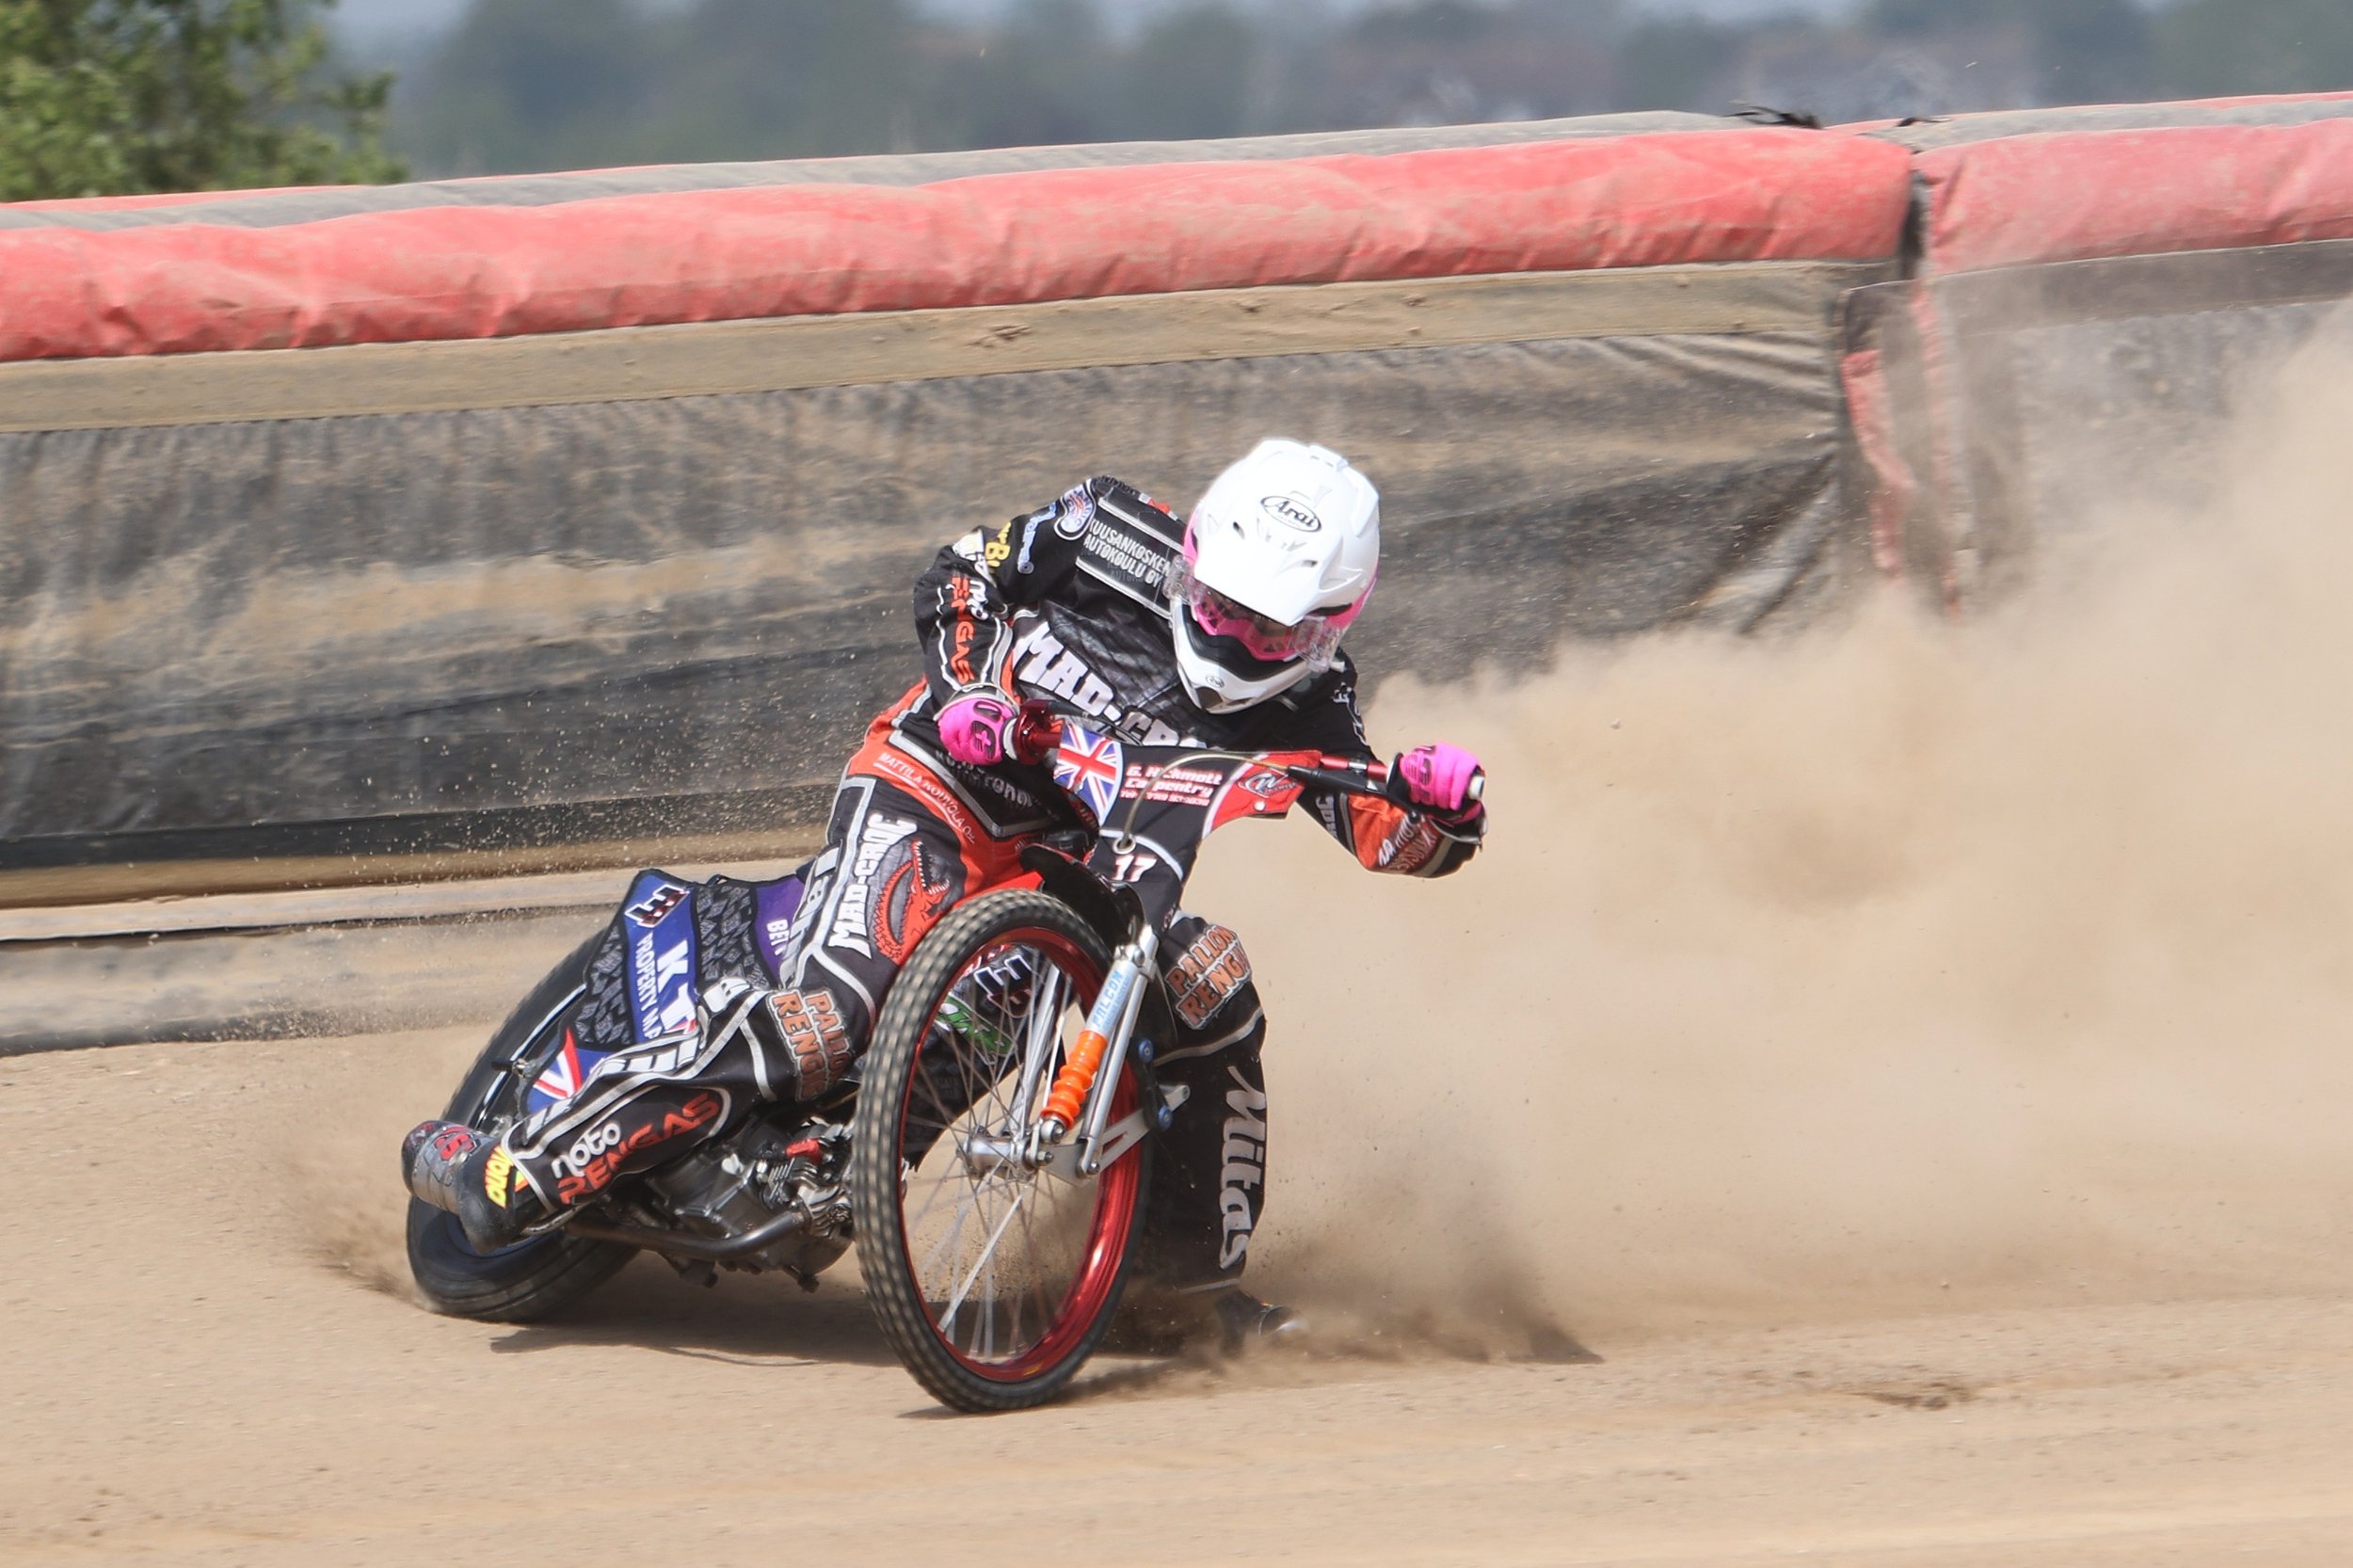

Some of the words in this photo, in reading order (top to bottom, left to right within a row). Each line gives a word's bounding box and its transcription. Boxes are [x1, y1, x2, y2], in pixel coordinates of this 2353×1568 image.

[1264, 500, 1316, 528] Arai
[1083, 534, 1146, 578] AUTOKOULU
[876, 752, 923, 784] MATTILA
[1125, 778, 1214, 798] Capentry
[1145, 764, 1224, 785] Hckmott
[828, 811, 918, 960] MAD-CROC
[1113, 854, 1158, 883] 17
[635, 932, 657, 1012] PROPERTY
[1093, 970, 1124, 1027] FALCON
[557, 1093, 721, 1204] RENGAS
[1220, 1065, 1266, 1270] Mitas
